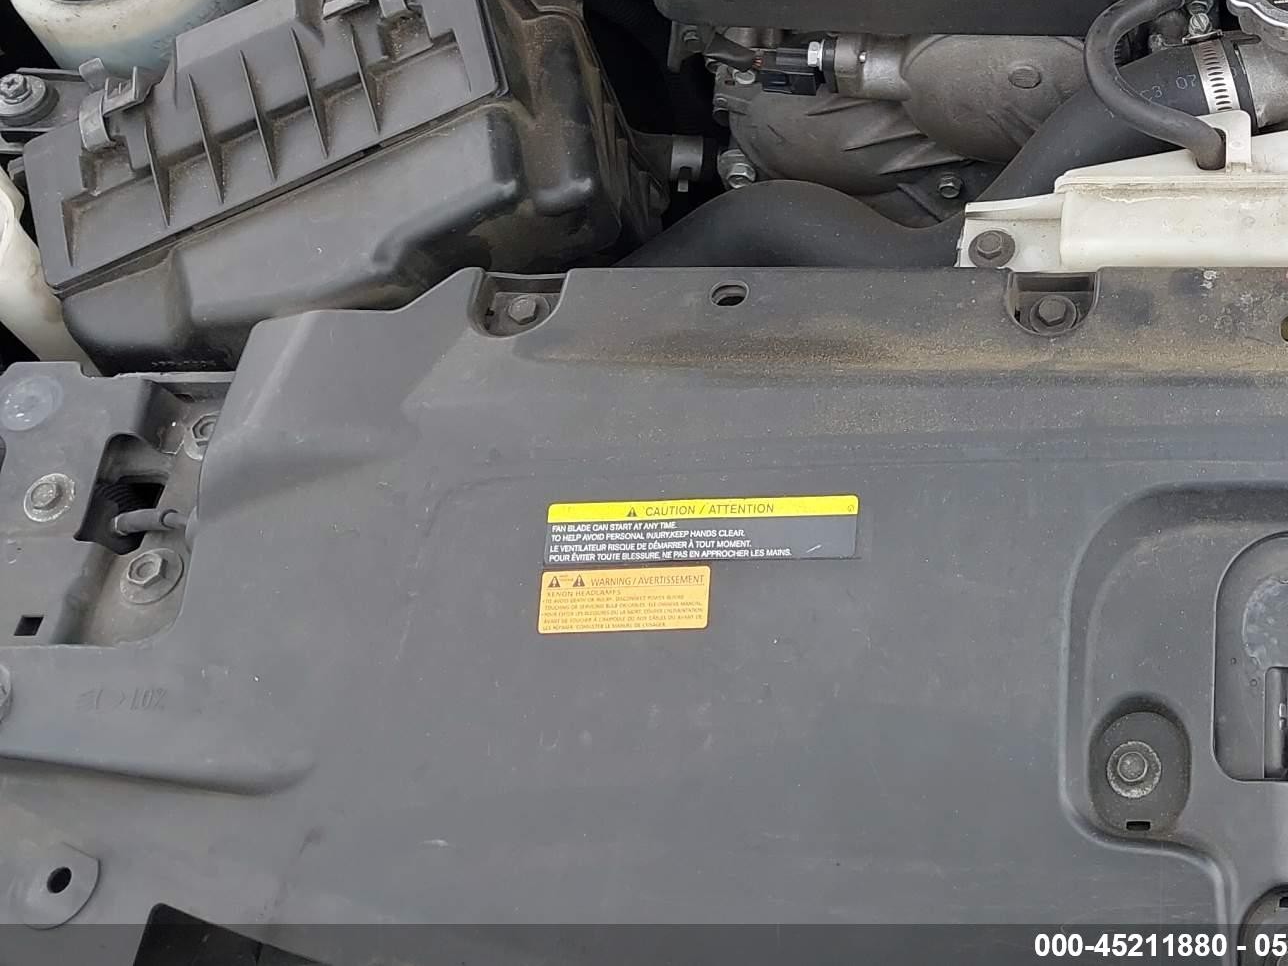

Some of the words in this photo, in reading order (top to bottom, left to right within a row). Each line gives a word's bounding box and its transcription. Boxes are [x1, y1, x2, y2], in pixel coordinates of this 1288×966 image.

[645, 506, 695, 516] CAUTION
[708, 503, 774, 515] ATTENTION
[551, 524, 566, 533] FAN
[567, 524, 591, 532] BLADE
[592, 523, 609, 532] CAN
[609, 523, 632, 531] START
[633, 522, 642, 530] AT
[643, 522, 659, 530] ANY
[660, 521, 678, 529] TIME.
[551, 534, 562, 542] TO
[562, 534, 582, 542] HELP
[582, 533, 605, 541] AVOID
[606, 532, 645, 541] PERSONAL
[689, 530, 717, 538] HANDS
[718, 529, 745, 537] CLEAR.
[550, 545, 559, 553] LE
[560, 544, 607, 552] VENTILATEUR
[607, 543, 636, 551] RISQUE
[636, 542, 648, 551] DE
[648, 540, 688, 550] DÉMARRER
[688, 539, 695, 549] À
[695, 540, 716, 548] TOUT
[716, 539, 752, 548] MOMENT.
[549, 554, 570, 562] POUR
[571, 552, 596, 561] ÉVITER
[662, 551, 673, 559] NE
[673, 550, 688, 558] PAS
[689, 550, 700, 558] EN
[702, 549, 749, 558] APPROCHER
[750, 549, 765, 557] LES
[766, 548, 792, 556] MAINS.
[591, 577, 631, 587] WARNING
[638, 575, 704, 586] AVERTISSEMENT
[547, 590, 574, 598] XENON
